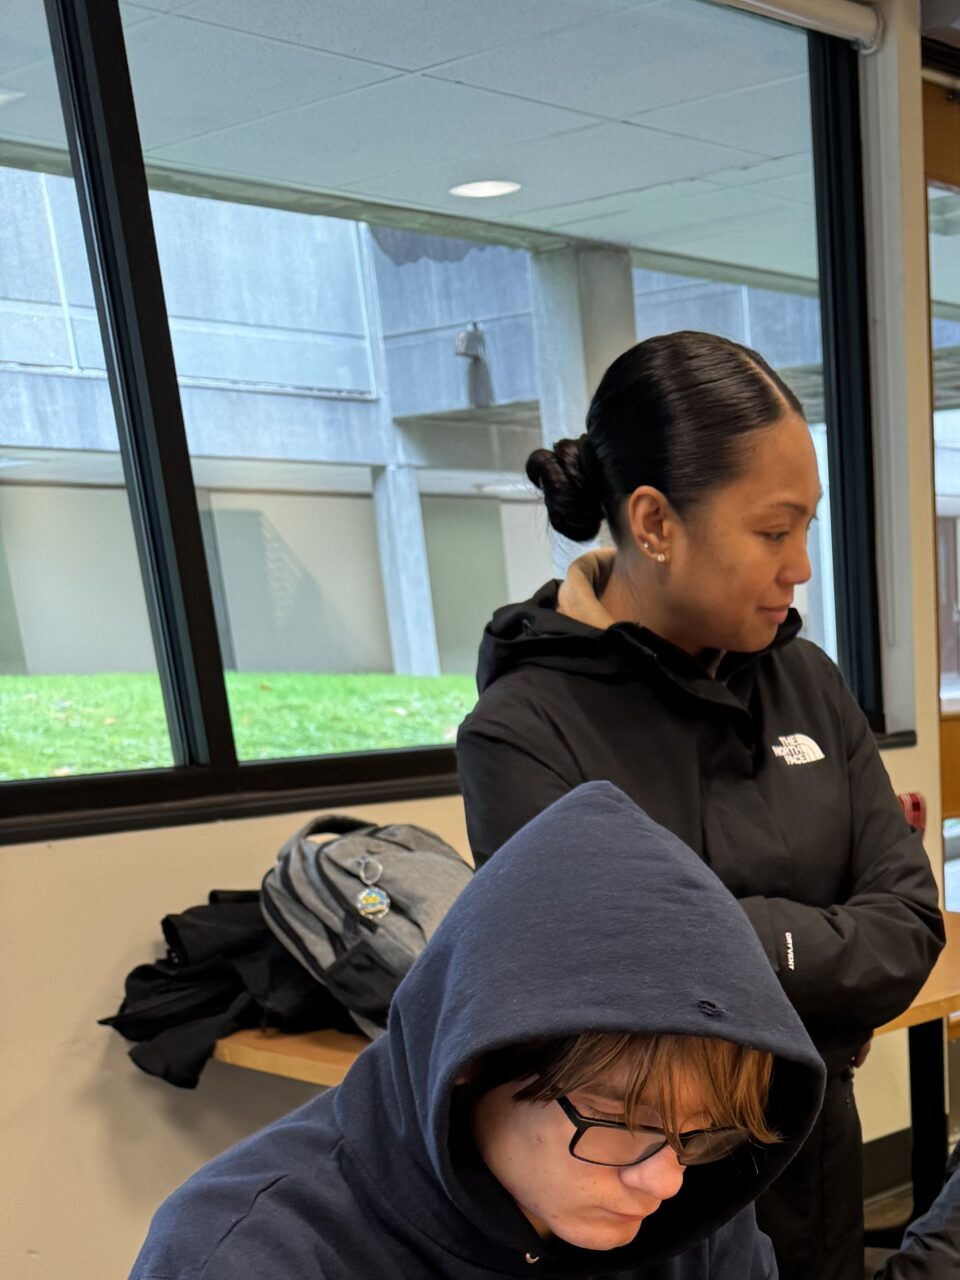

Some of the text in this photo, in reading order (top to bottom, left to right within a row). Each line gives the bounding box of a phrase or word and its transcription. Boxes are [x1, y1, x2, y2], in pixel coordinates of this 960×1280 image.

[778, 735, 798, 748] THE
[771, 743, 802, 758] NORTH
[784, 752, 807, 766] FACE
